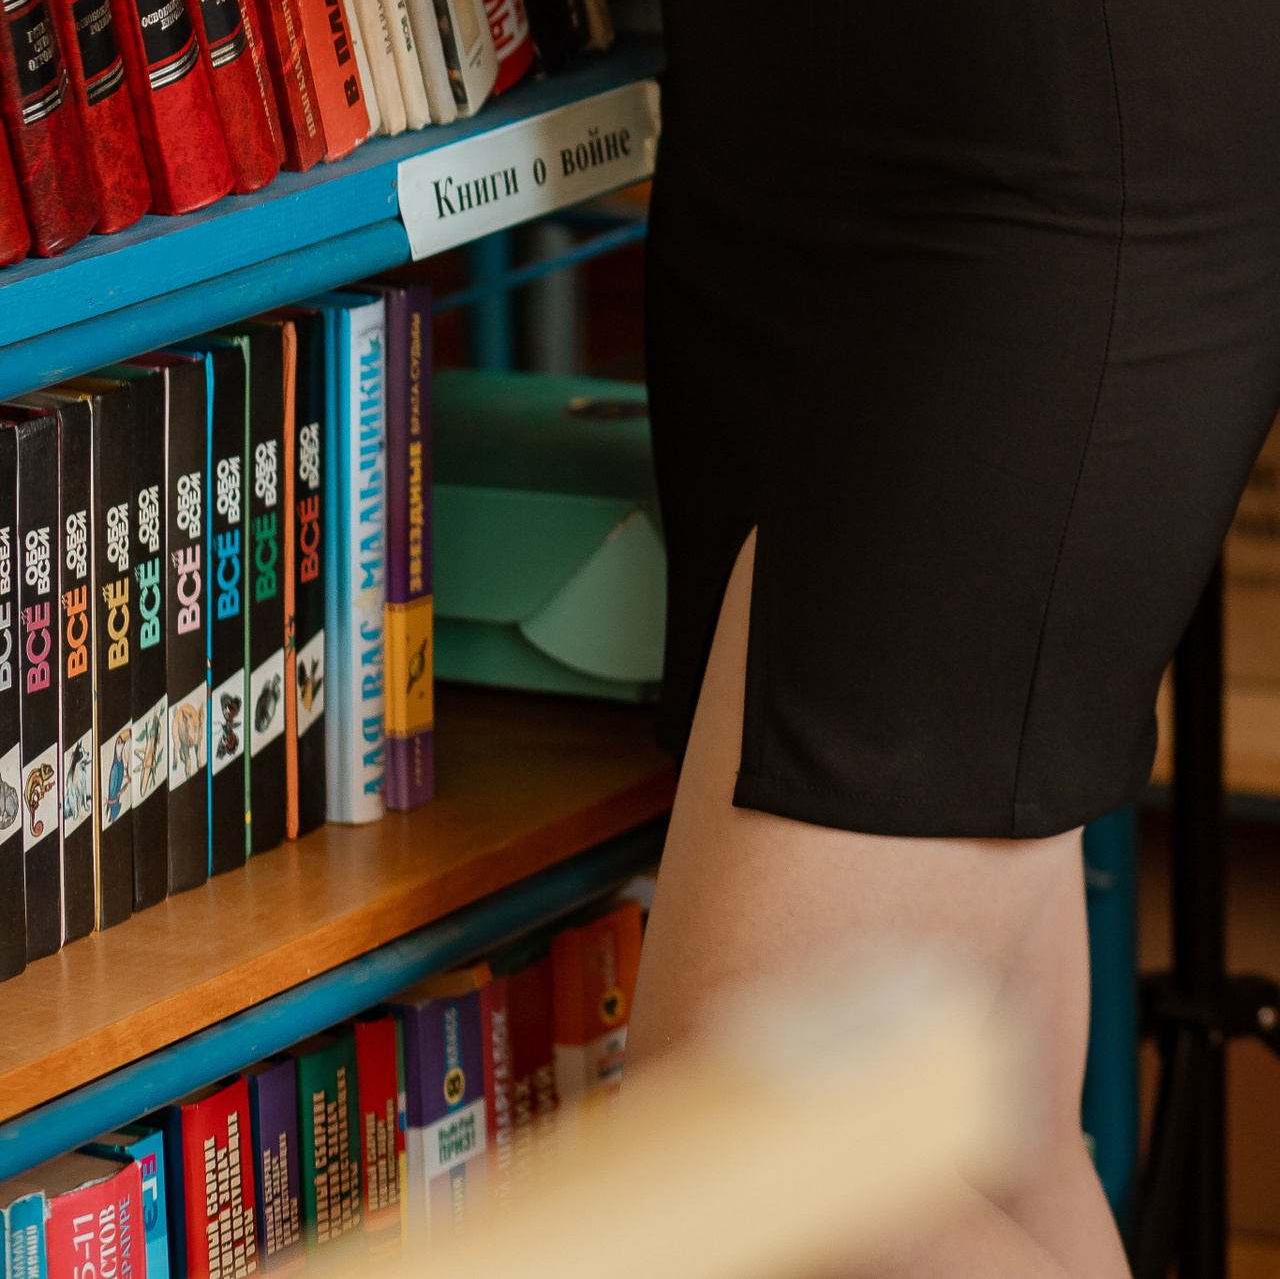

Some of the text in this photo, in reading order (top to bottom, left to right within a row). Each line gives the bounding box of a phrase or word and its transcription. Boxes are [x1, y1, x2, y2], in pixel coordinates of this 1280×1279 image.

[343, 74, 360, 108] В
[432, 127, 632, 220] Книги о войне
[255, 442, 266, 499] ОБО
[265, 439, 277, 508] ВСЕМ
[299, 425, 311, 481] ОБО
[357, 348, 385, 593] МАЛЬЧИКИ
[138, 489, 150, 544] ОБО
[149, 485, 160, 553] ВСЕМ
[177, 474, 190, 530] ОБО
[189, 471, 201, 539] ВСЕМ
[217, 459, 229, 515] ОБО
[228, 455, 241, 525] ВСЕМ
[26, 530, 38, 586] ОБО
[38, 526, 50, 595] ВСЕМ
[66, 514, 77, 570] ОБО
[76, 510, 87, 579] ВСЕМ
[107, 506, 119, 563] ОБО
[119, 503, 129, 573] ВСЕМ
[360, 713, 386, 798] ДЛЯ
[312, 1090, 326, 1169] СБОРНИК
[141, 1152, 158, 1231] ЕГЭ
[204, 1136, 218, 1217] СБОРНИК
[98, 1204, 118, 1279] СТОВ
